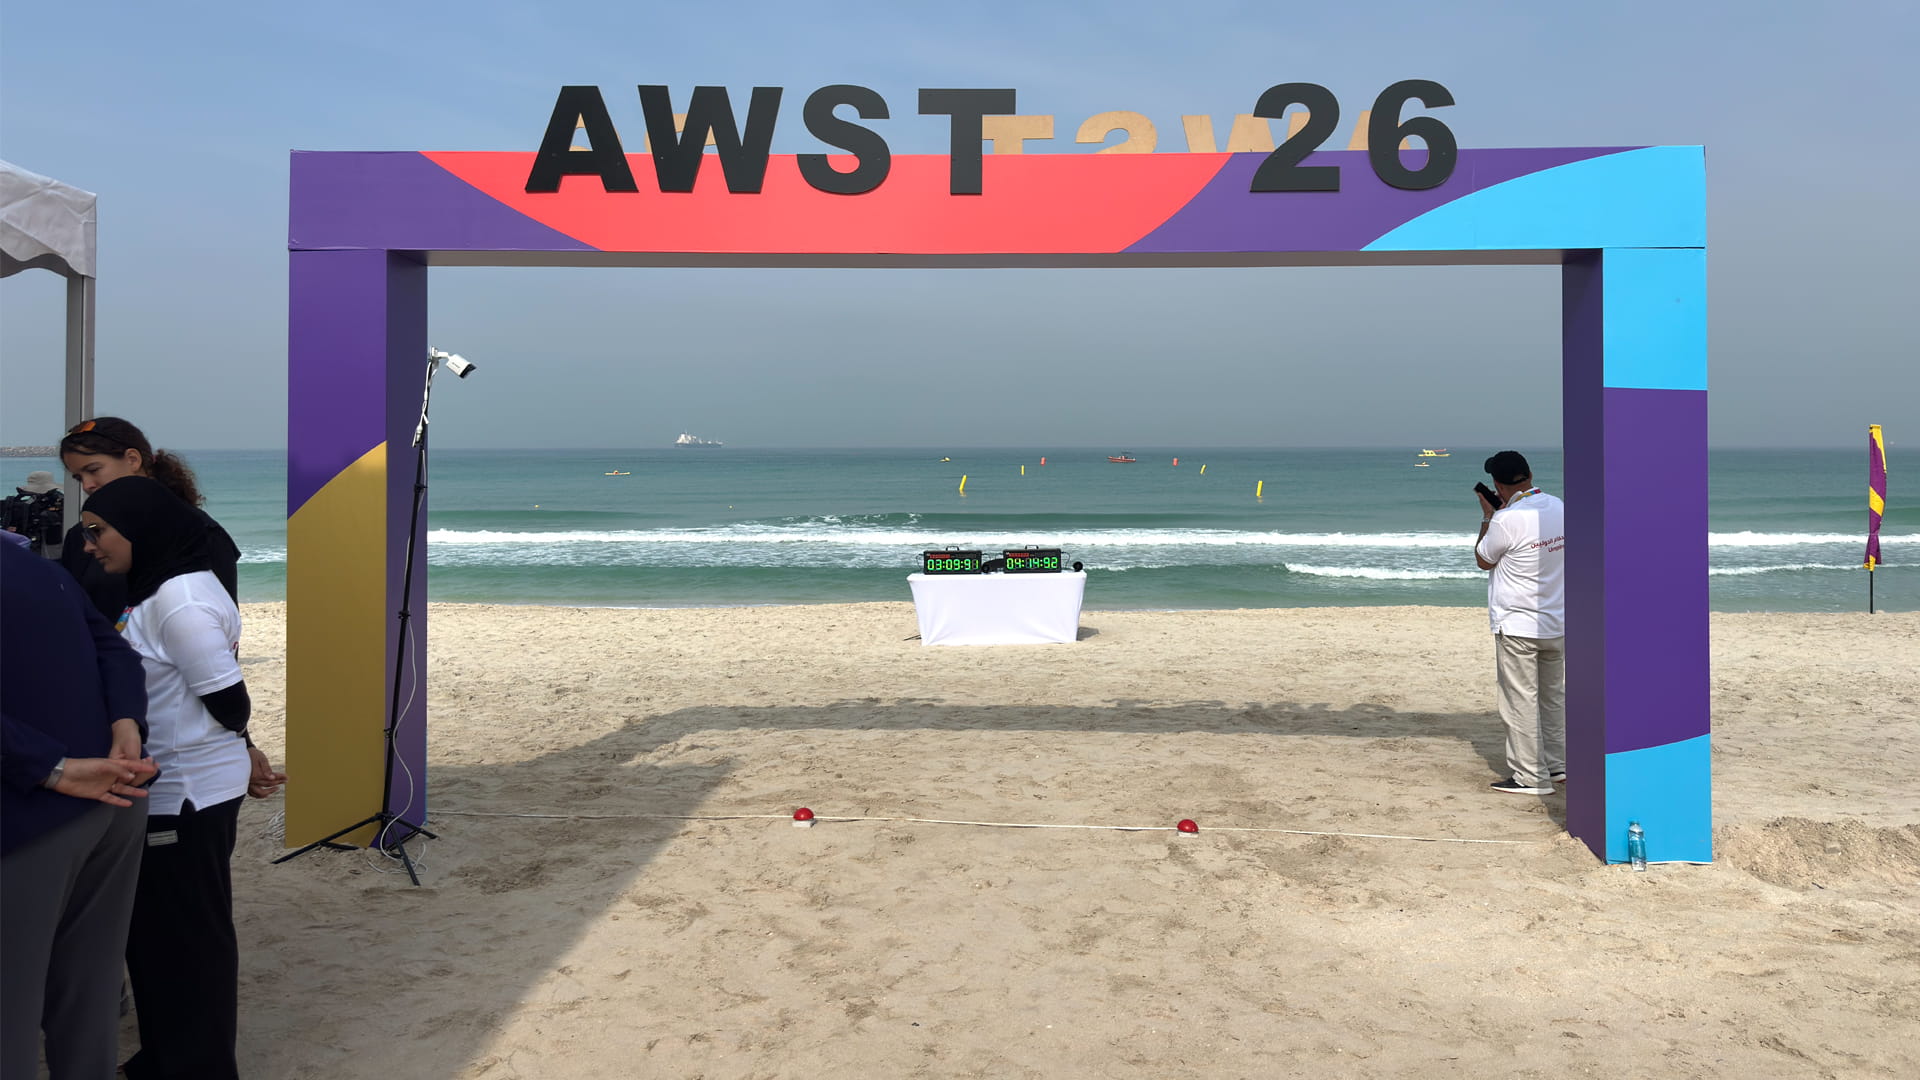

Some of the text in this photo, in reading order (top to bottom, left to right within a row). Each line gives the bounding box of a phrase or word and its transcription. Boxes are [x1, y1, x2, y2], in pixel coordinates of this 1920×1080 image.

[525, 79, 1457, 196] AWST 26
[927, 558, 979, 571] 03:09:91
[1006, 556, 1058, 570] 04:14:92
